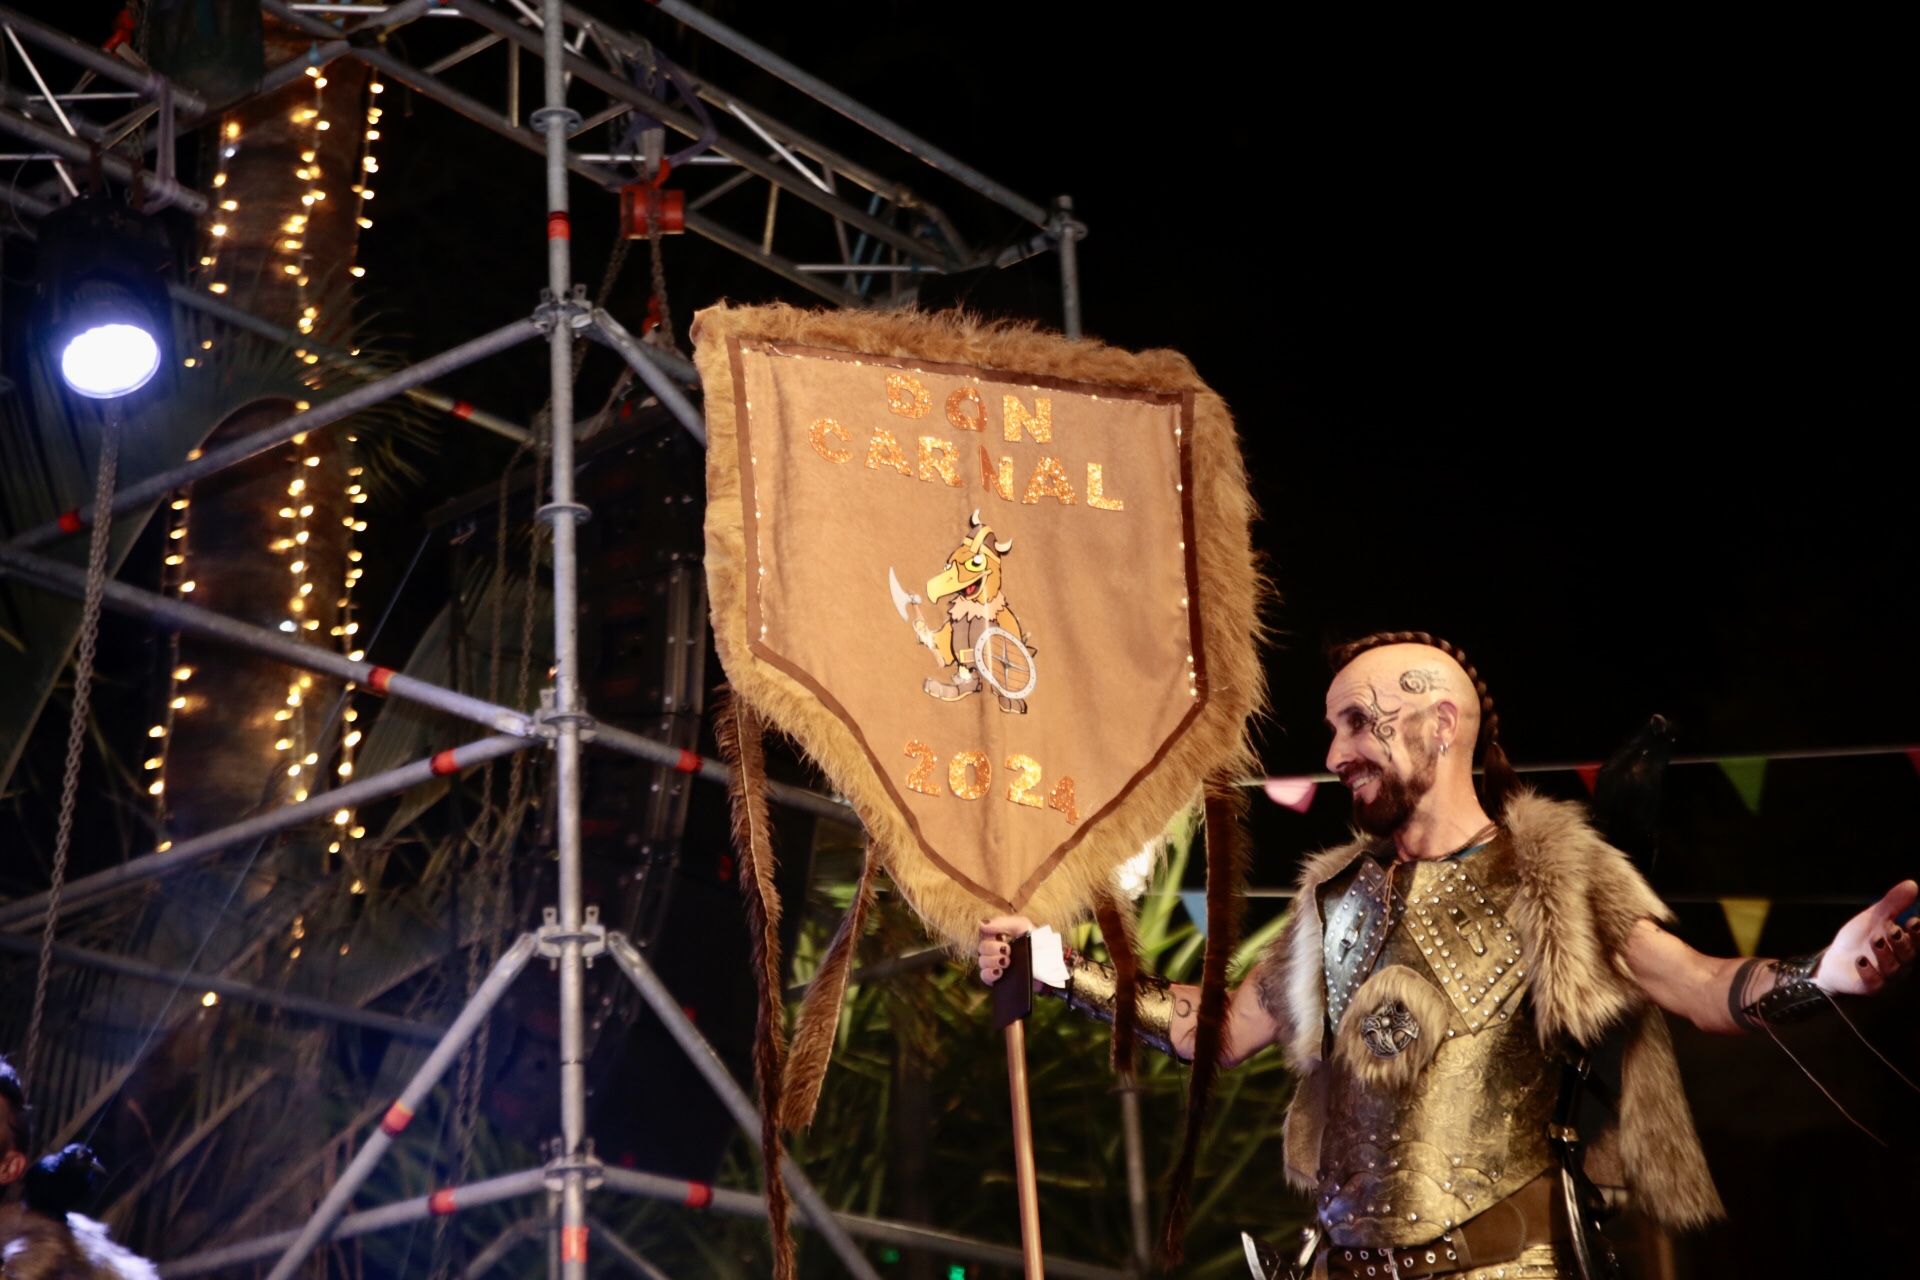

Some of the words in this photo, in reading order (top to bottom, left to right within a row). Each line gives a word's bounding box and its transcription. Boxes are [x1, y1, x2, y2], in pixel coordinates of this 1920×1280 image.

[886, 374, 1052, 444] DON
[808, 416, 1124, 512] CARNAL
[904, 739, 1080, 825] 2024
